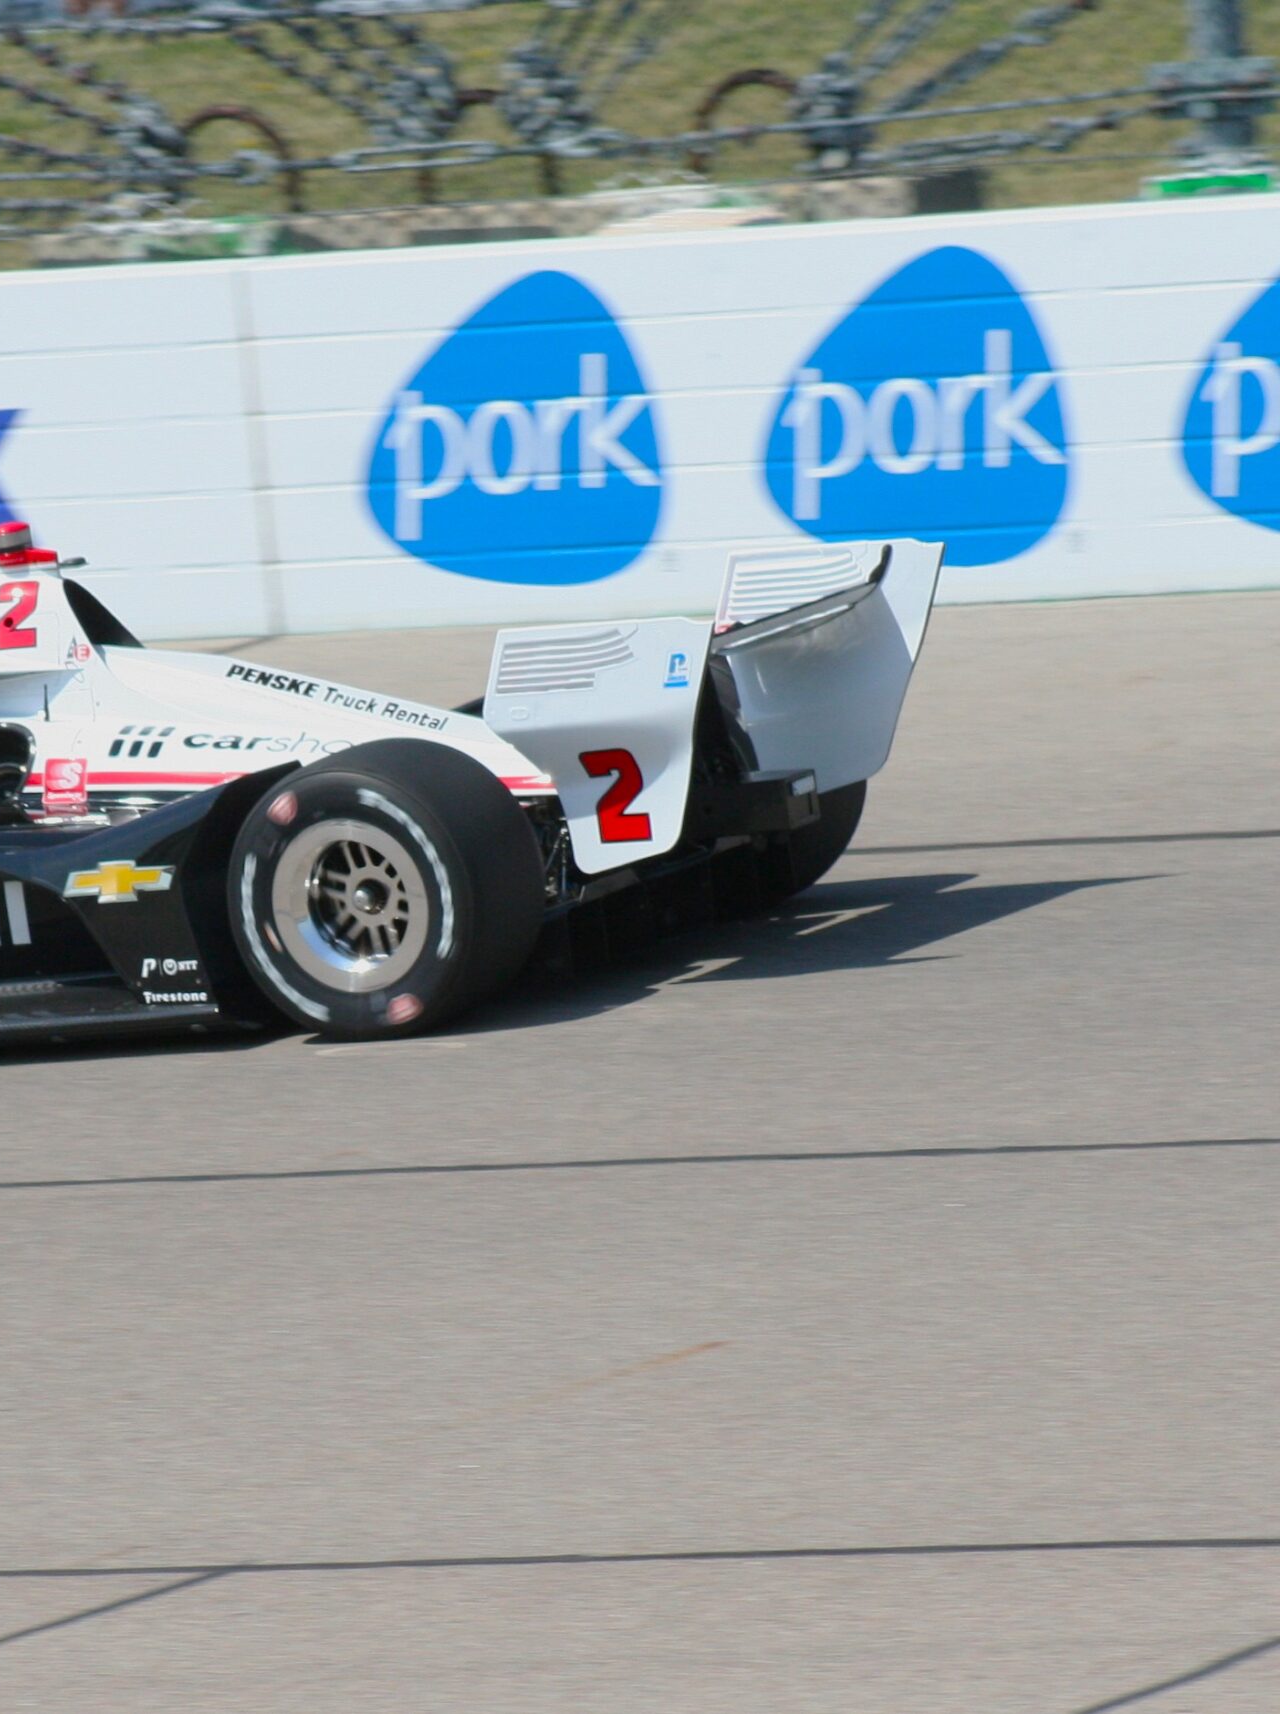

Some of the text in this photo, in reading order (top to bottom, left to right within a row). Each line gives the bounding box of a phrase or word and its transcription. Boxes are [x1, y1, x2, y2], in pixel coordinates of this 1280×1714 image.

[383, 353, 662, 540] pork
[780, 329, 1072, 520] pork
[224, 663, 450, 731] PENSKE Truck Rental
[578, 748, 653, 844] 2
[142, 991, 208, 1004] Firestone
